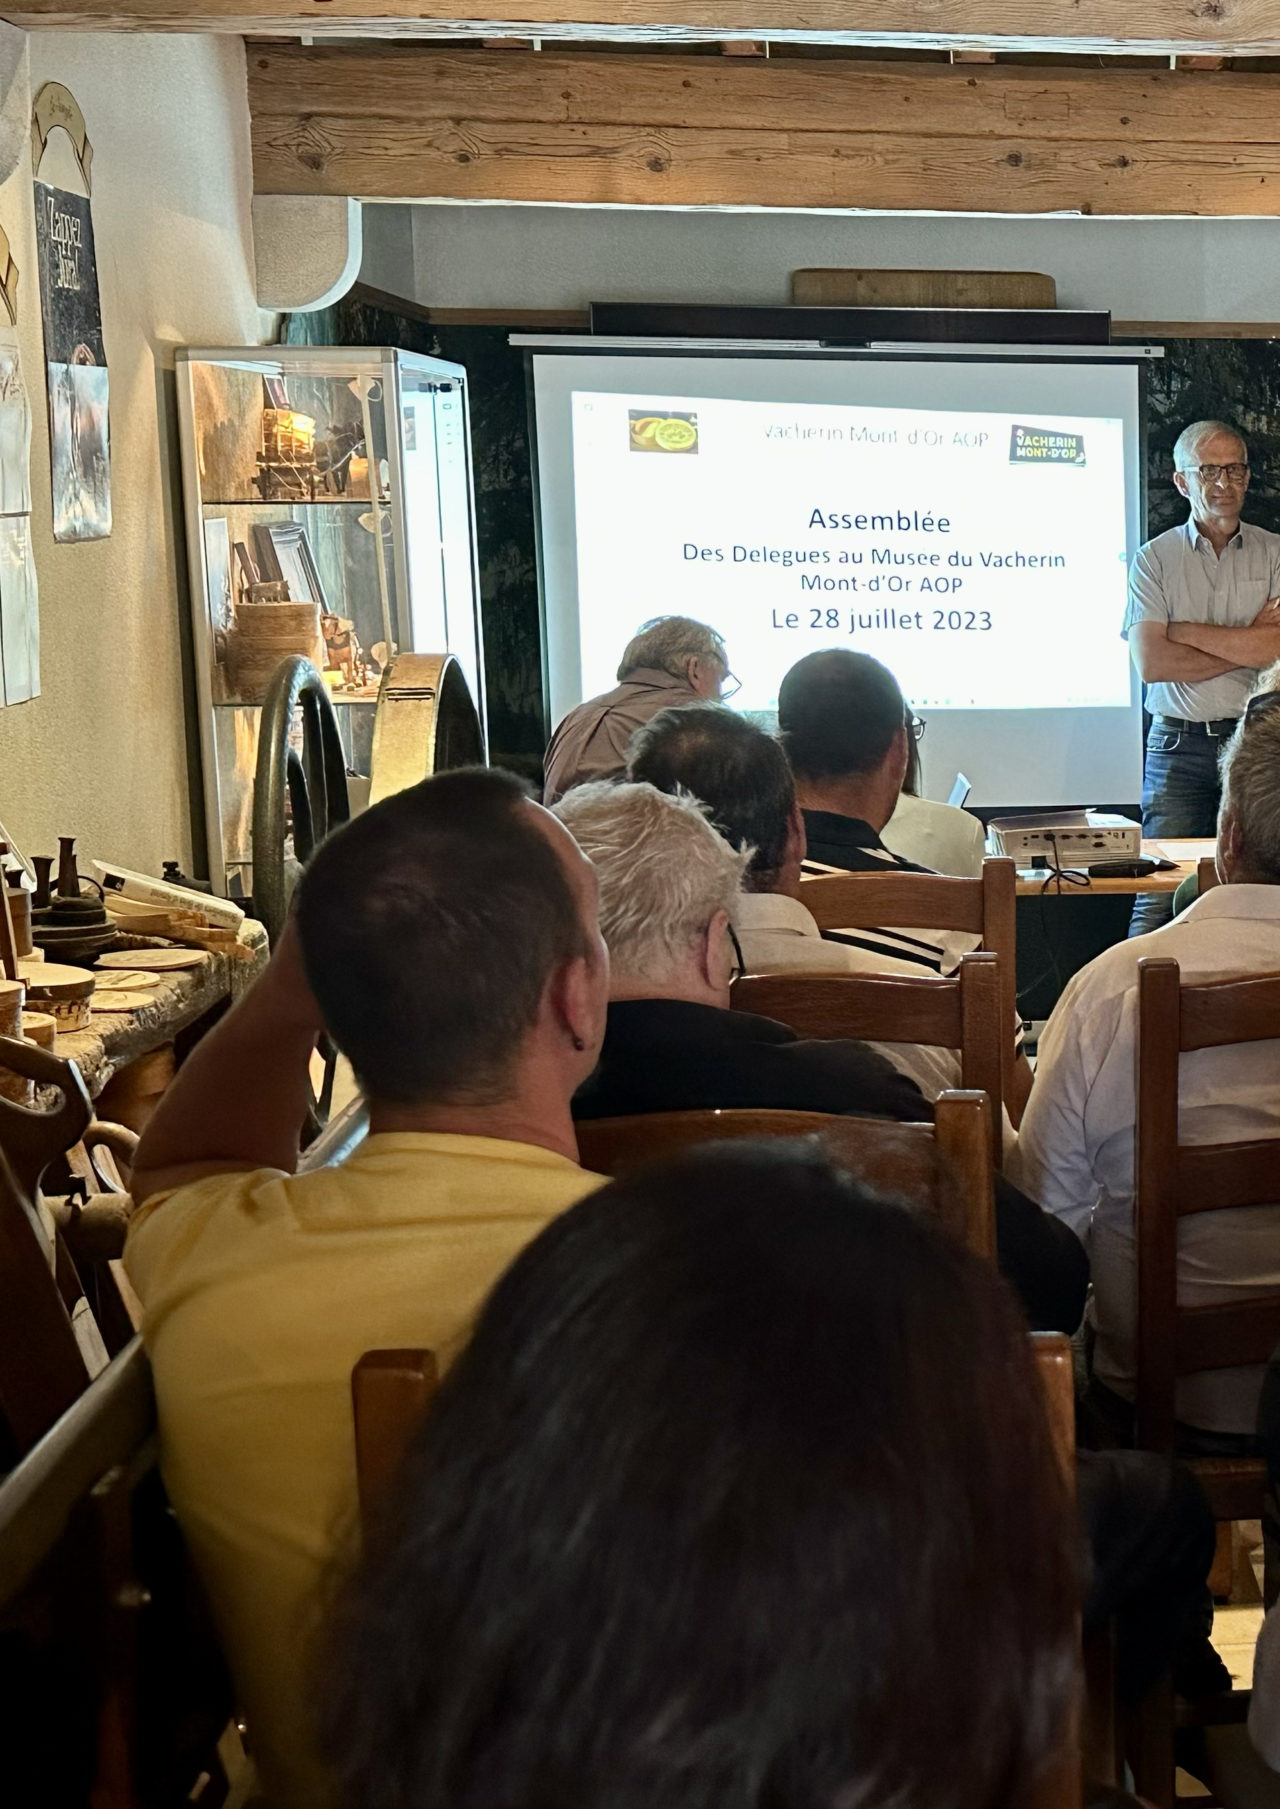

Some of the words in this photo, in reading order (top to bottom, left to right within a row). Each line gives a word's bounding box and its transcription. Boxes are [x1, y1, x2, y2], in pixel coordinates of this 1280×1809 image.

[763, 422, 844, 441] Vacherin
[850, 426, 897, 443] Mont
[952, 431, 989, 447] AOP
[1016, 434, 1077, 448] VACHERIN
[808, 508, 951, 533] Assemblée
[683, 543, 724, 562] Des
[733, 545, 831, 567] Delegues
[838, 551, 864, 564] au
[947, 551, 973, 567] du
[979, 551, 1066, 568] Vacherin
[801, 574, 912, 592] Mont-d'Or
[920, 577, 963, 594] AOP
[772, 608, 799, 629] Le
[809, 608, 840, 629] 28
[848, 608, 923, 635] juillet
[932, 610, 992, 631] 2023
